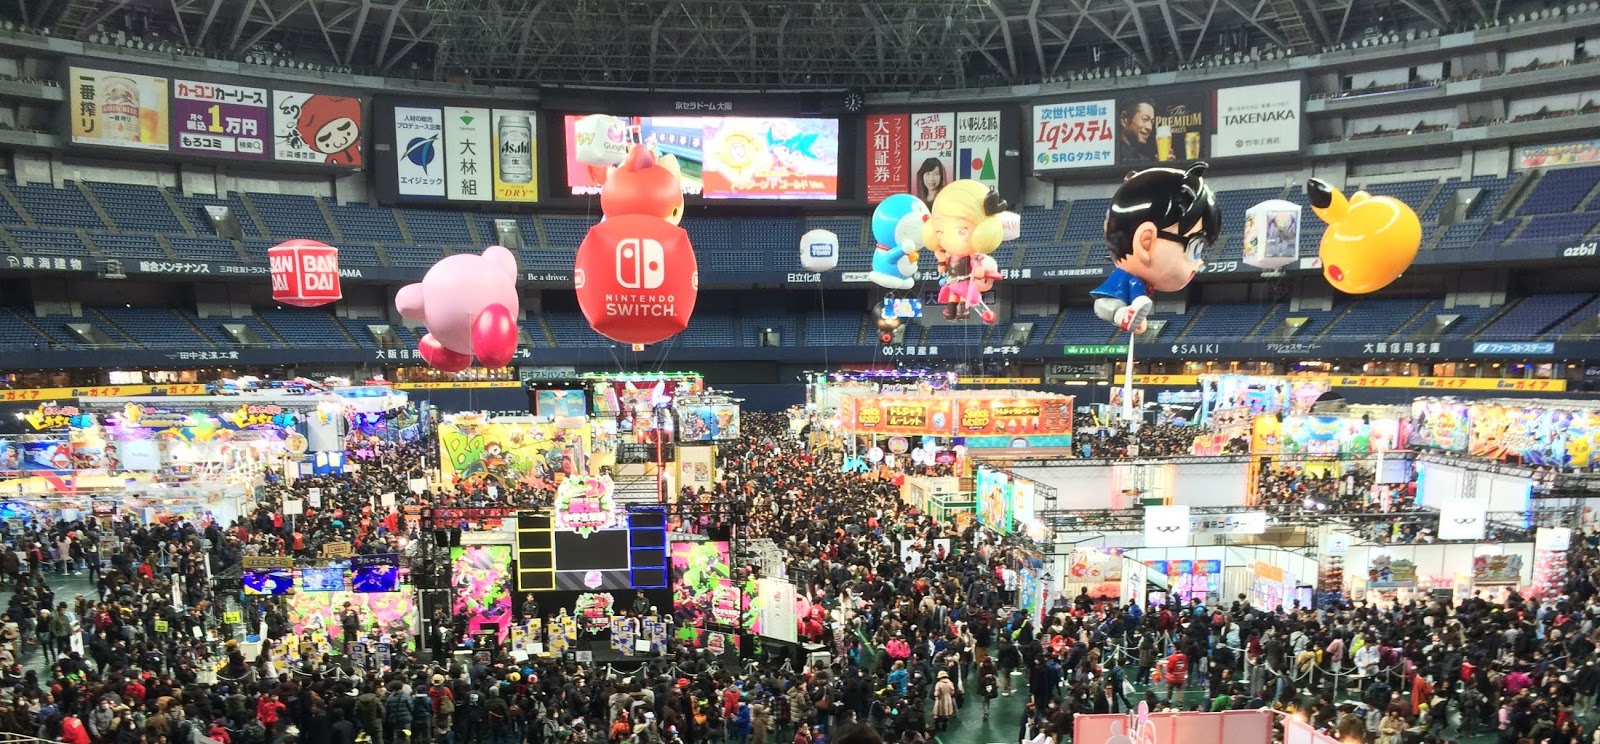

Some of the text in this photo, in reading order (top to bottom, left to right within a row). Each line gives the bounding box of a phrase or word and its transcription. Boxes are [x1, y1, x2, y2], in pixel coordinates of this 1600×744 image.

[178, 84, 263, 104] カーコンカーリース
[80, 76, 96, 133] 一番搾り
[675, 102, 732, 111] 京セラドーム大阪
[1041, 104, 1107, 120] 次世代足場は
[1222, 110, 1295, 126] TAKENAKA
[208, 105, 258, 136] 1万円
[404, 115, 433, 123] 人材の総合
[1156, 112, 1202, 127] PREMIUM
[397, 122, 442, 130] プロデュース企業
[921, 125, 947, 140] 高須
[1036, 119, 1113, 150] Iqシステム
[182, 137, 222, 149] もろコミ
[501, 140, 529, 154] Asahi
[913, 140, 953, 151] クリニック
[1245, 137, 1280, 147] 竹中工務店
[874, 118, 890, 183] 大和証券
[893, 118, 902, 182] ファンドラップは
[938, 150, 952, 158] 大阪
[1051, 151, 1111, 163] SRGタカミヤ
[460, 139, 477, 195] 大林組
[400, 176, 443, 185] エイジェック
[1563, 242, 1598, 257] azbil
[22, 256, 82, 270] 東海建物
[140, 261, 210, 274] 総合メンテナンス
[303, 255, 337, 273] BAN
[1208, 261, 1238, 272] フジタ
[305, 274, 333, 291] DAI
[527, 273, 537, 281] Be
[545, 273, 569, 281] driver.
[787, 273, 821, 282] 日立化成
[605, 294, 675, 303] NINTENDO
[606, 303, 675, 316] SWITCH
[983, 346, 1020, 354] ホーチキ
[1181, 344, 1219, 354] SAIKI
[1363, 342, 1441, 353] 大阪信用金庫
[1436, 379, 1467, 387] ガイア
[1516, 381, 1549, 389] ガイア
[7, 391, 39, 399] ガイア
[90, 388, 120, 397] ガイア
[169, 386, 200, 394] ガイア
